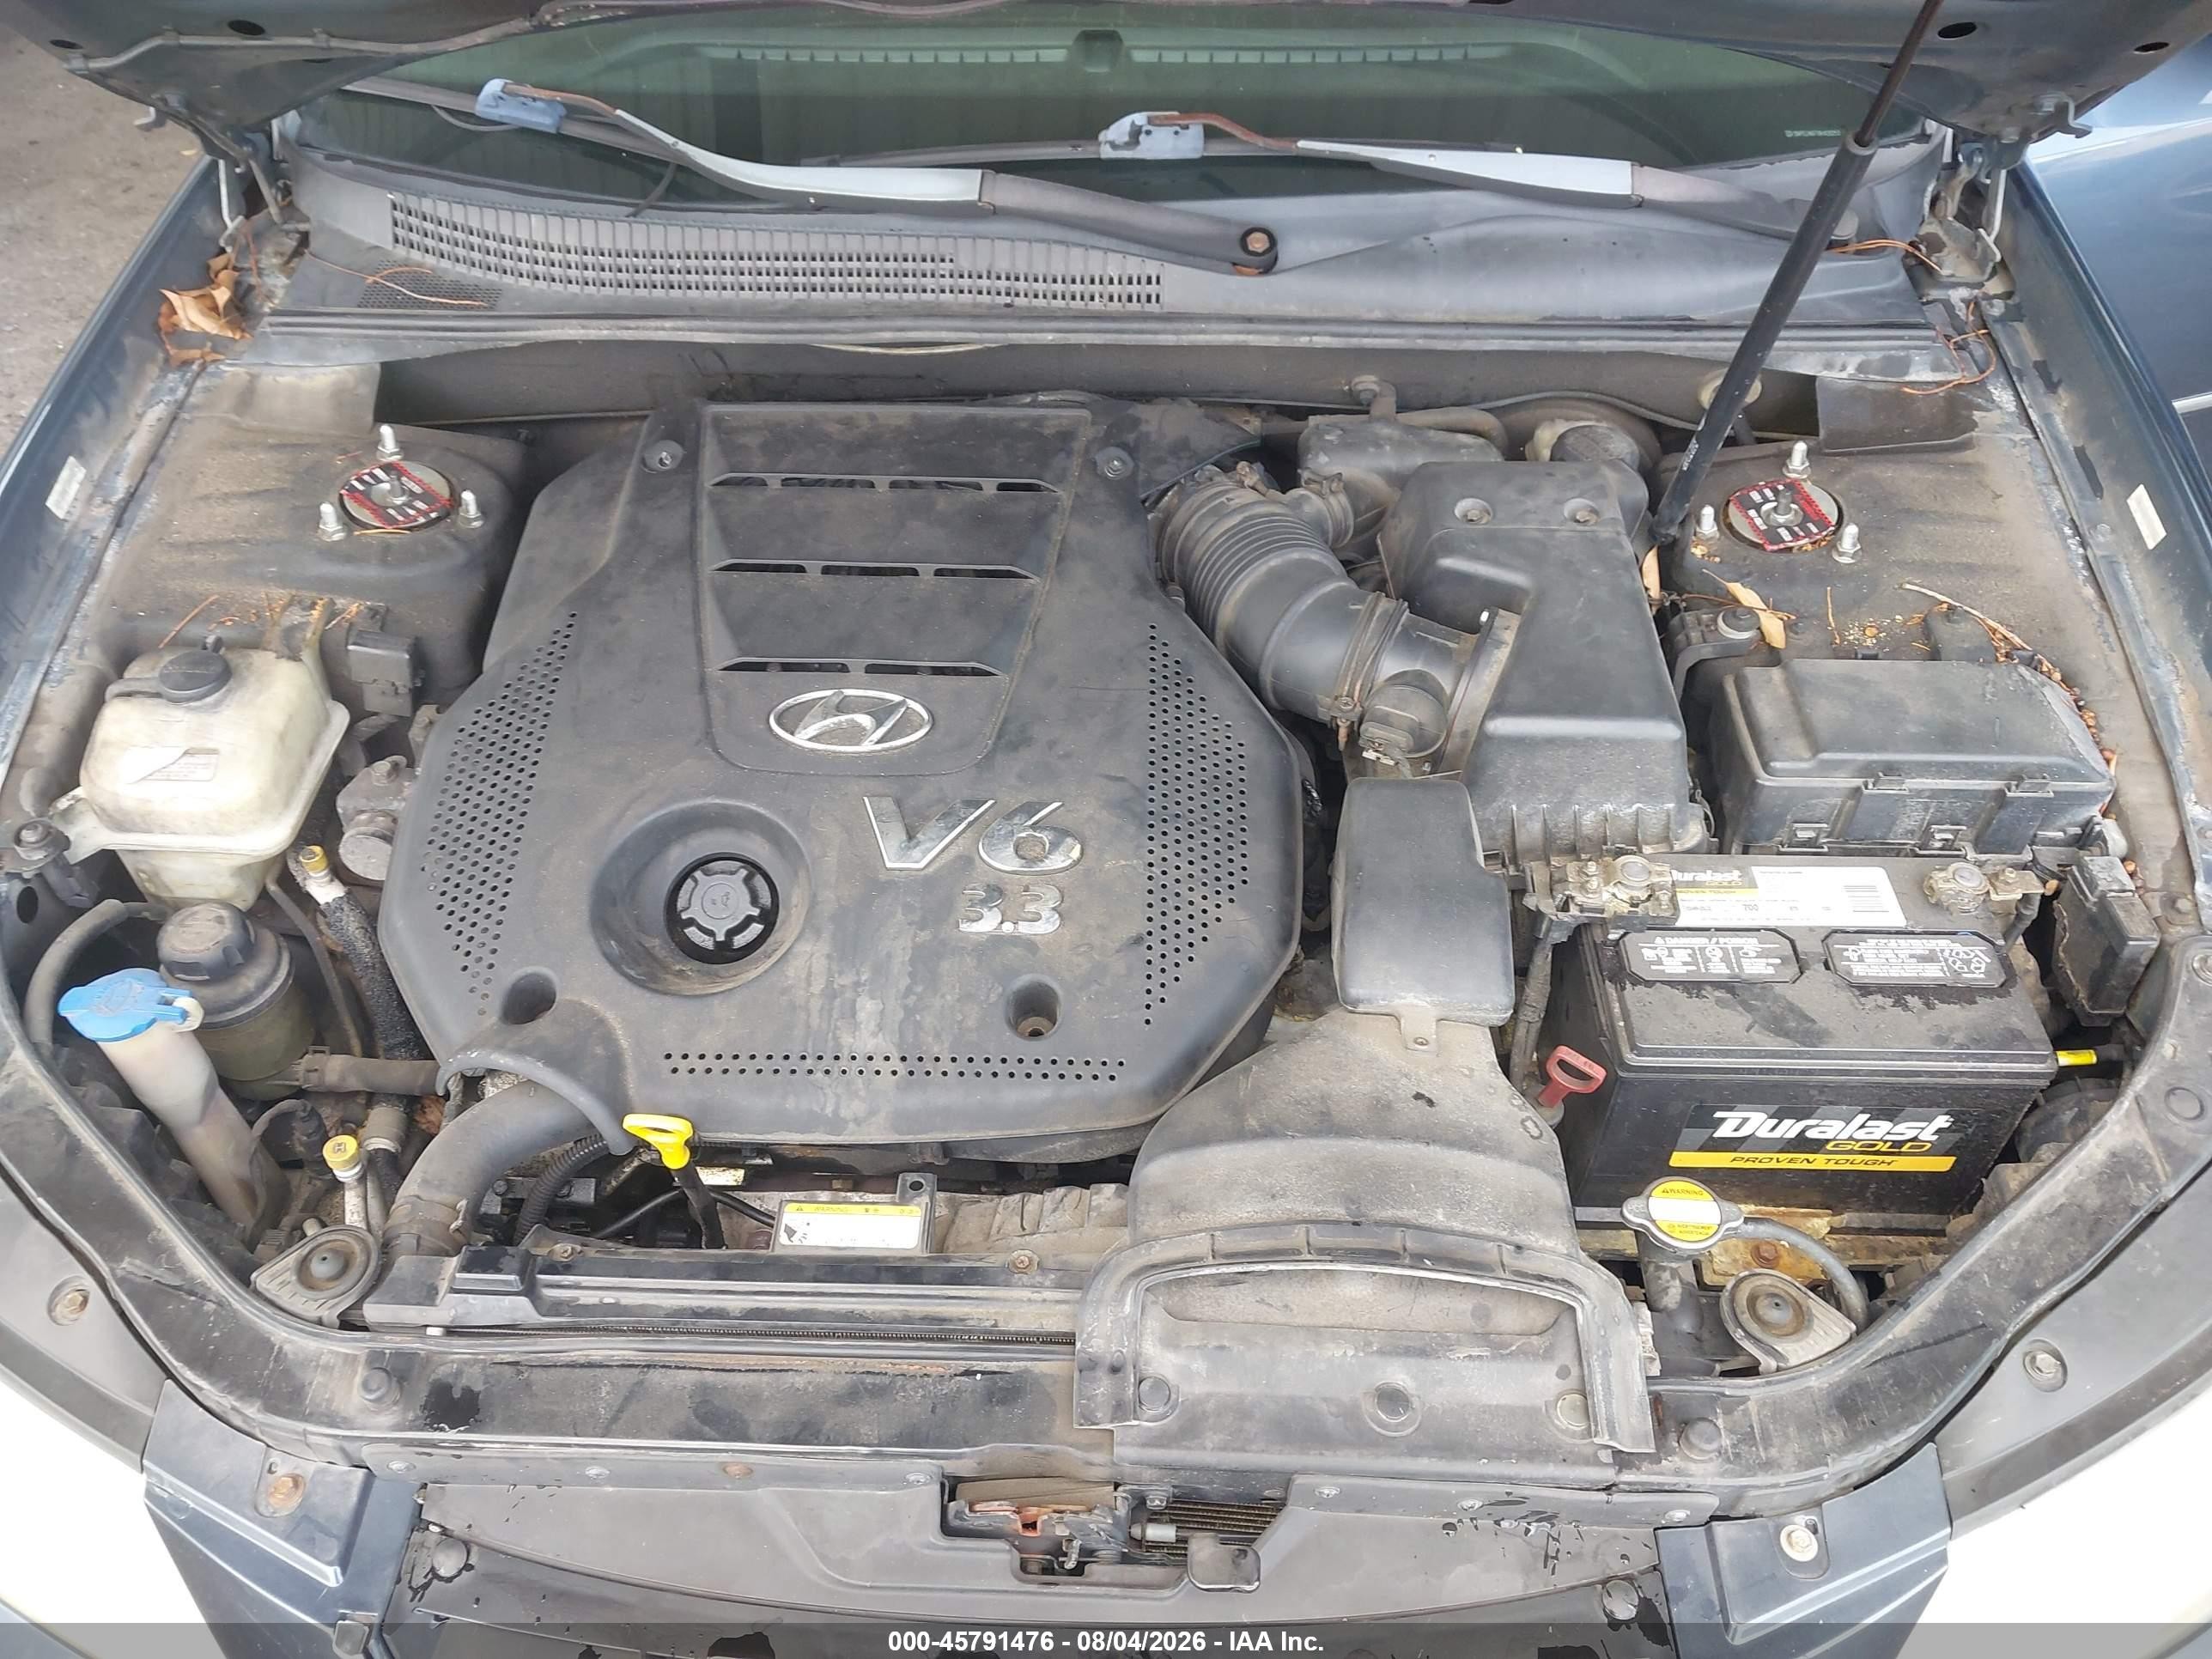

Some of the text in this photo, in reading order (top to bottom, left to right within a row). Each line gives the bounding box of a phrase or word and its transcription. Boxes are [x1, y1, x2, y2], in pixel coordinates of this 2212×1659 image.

[862, 795, 1085, 877] V6
[957, 883, 1065, 935] 3.3
[1712, 1111, 1955, 1141] Duralast
[1825, 1140, 1934, 1152] GOLD
[1730, 1156, 1896, 1167] PROVEN TOUGH
[1669, 1188, 1704, 1196] WARNING
